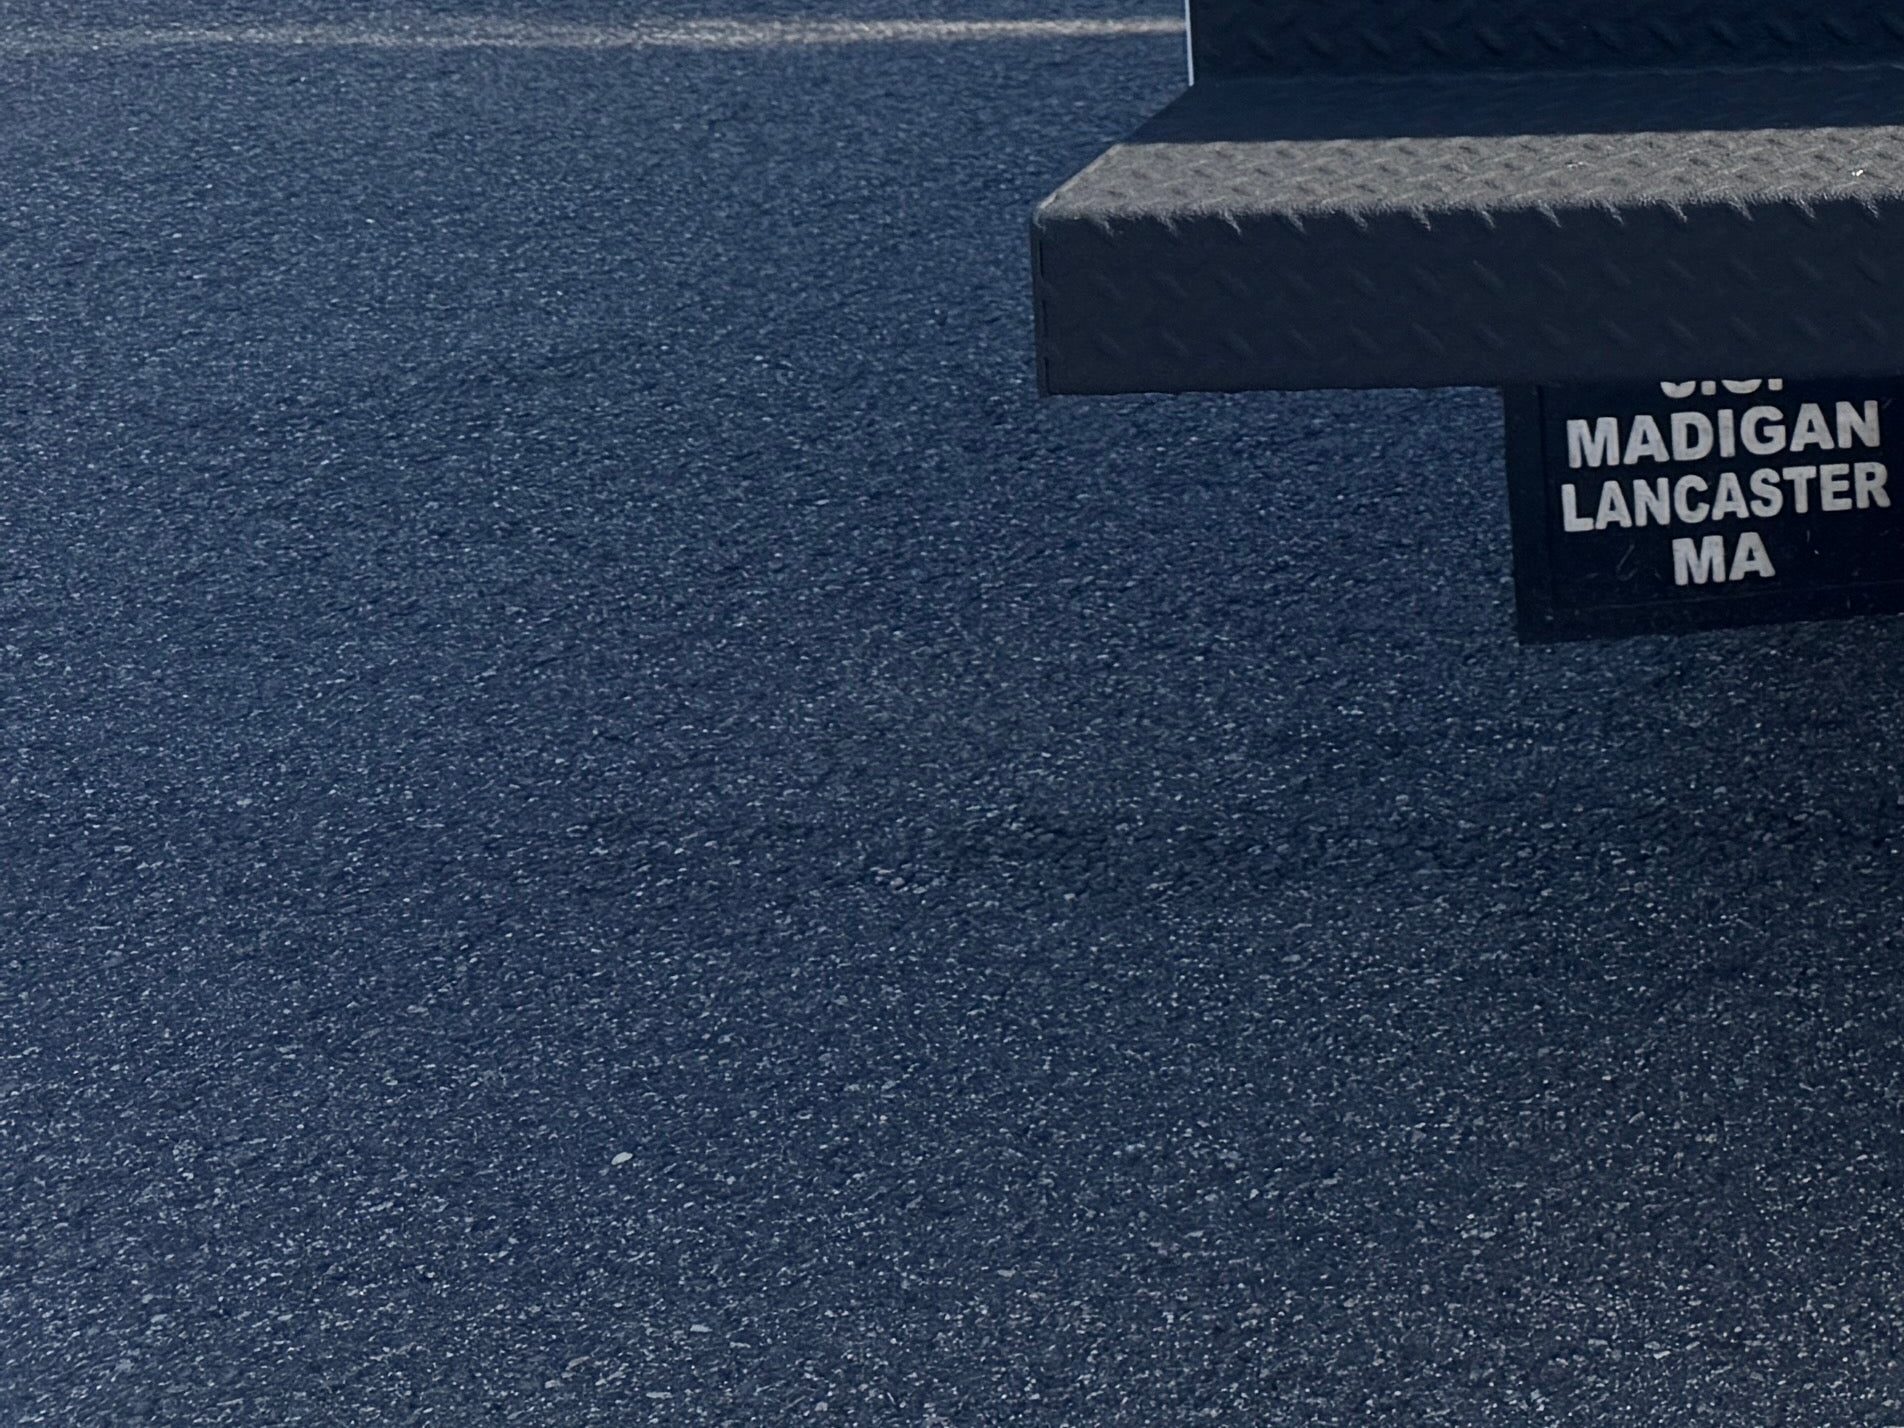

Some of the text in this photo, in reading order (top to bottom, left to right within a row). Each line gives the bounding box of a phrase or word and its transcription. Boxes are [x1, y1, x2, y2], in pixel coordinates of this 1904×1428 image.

[1566, 400, 1881, 469] MADIGAN
[1561, 462, 1891, 532] LANCASTER
[1672, 532, 1776, 586] MA
